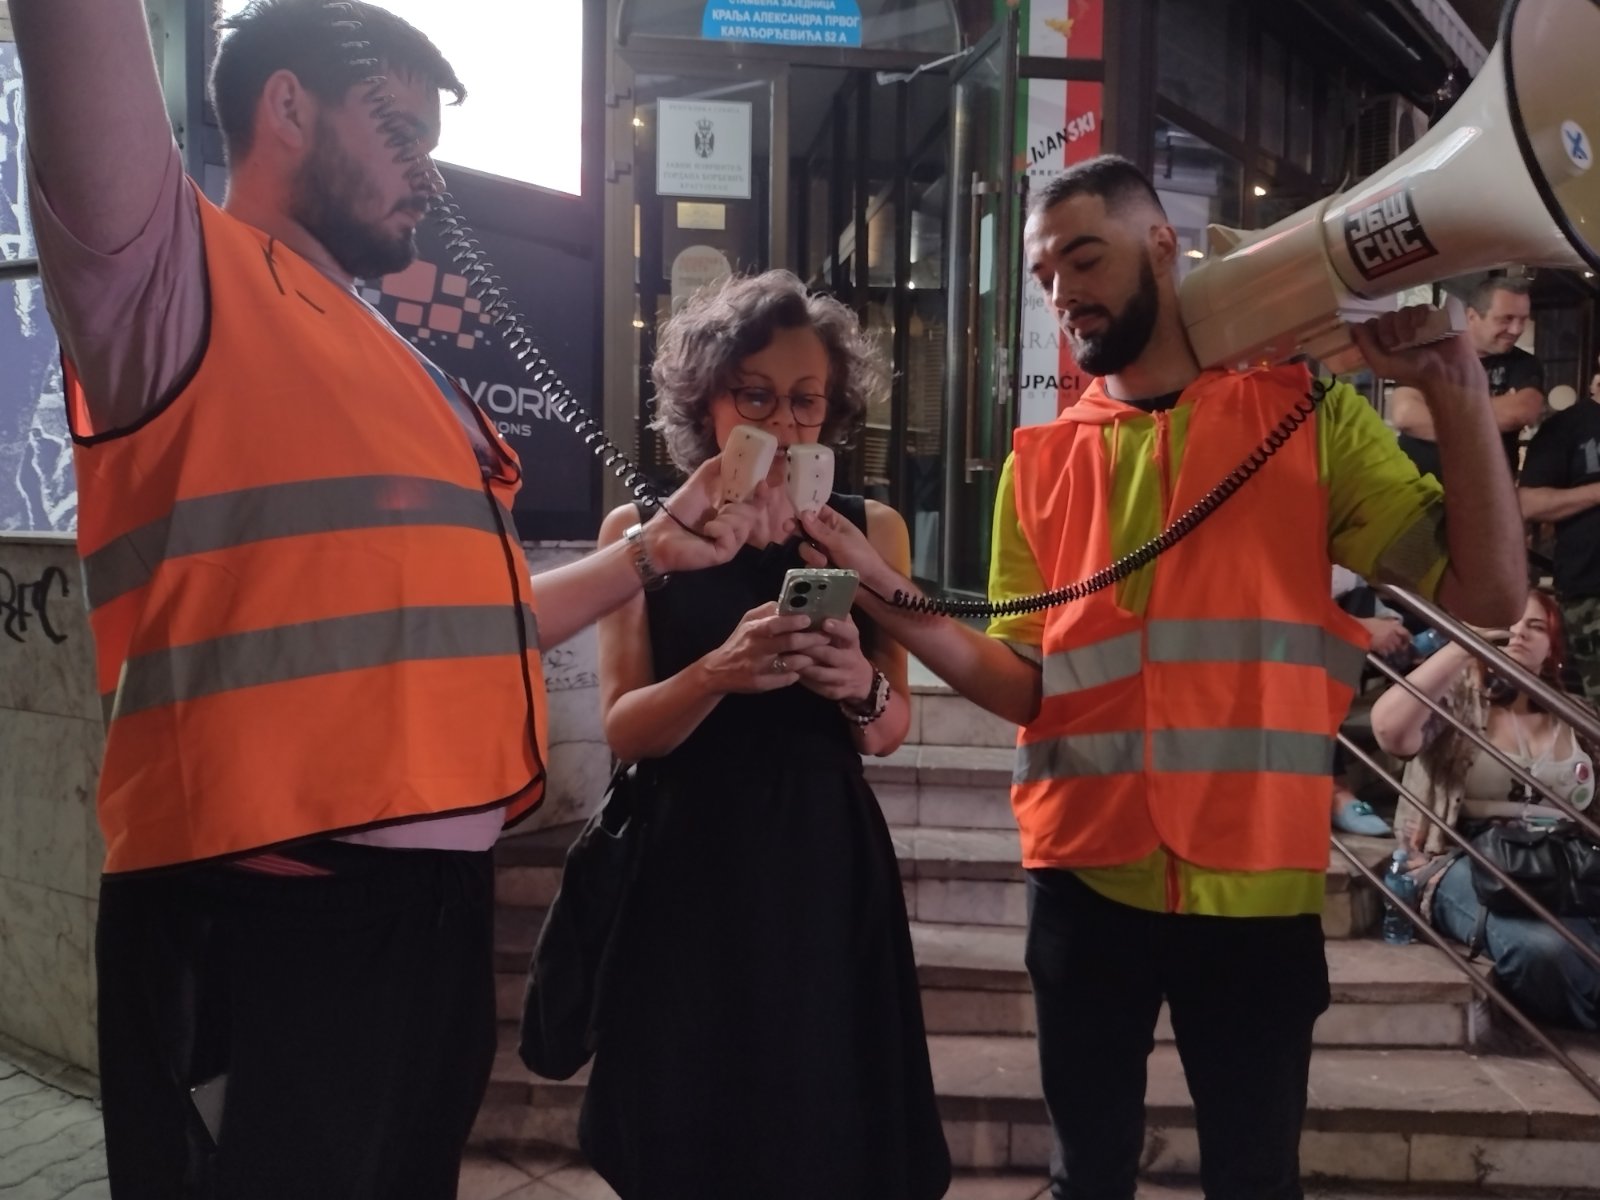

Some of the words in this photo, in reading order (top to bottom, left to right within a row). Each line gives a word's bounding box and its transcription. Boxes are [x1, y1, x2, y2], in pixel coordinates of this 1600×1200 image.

[712, 9, 751, 21] КРАЉА
[753, 11, 823, 27] АЛЕКСАНДРА
[824, 15, 860, 28] ПРВОГ
